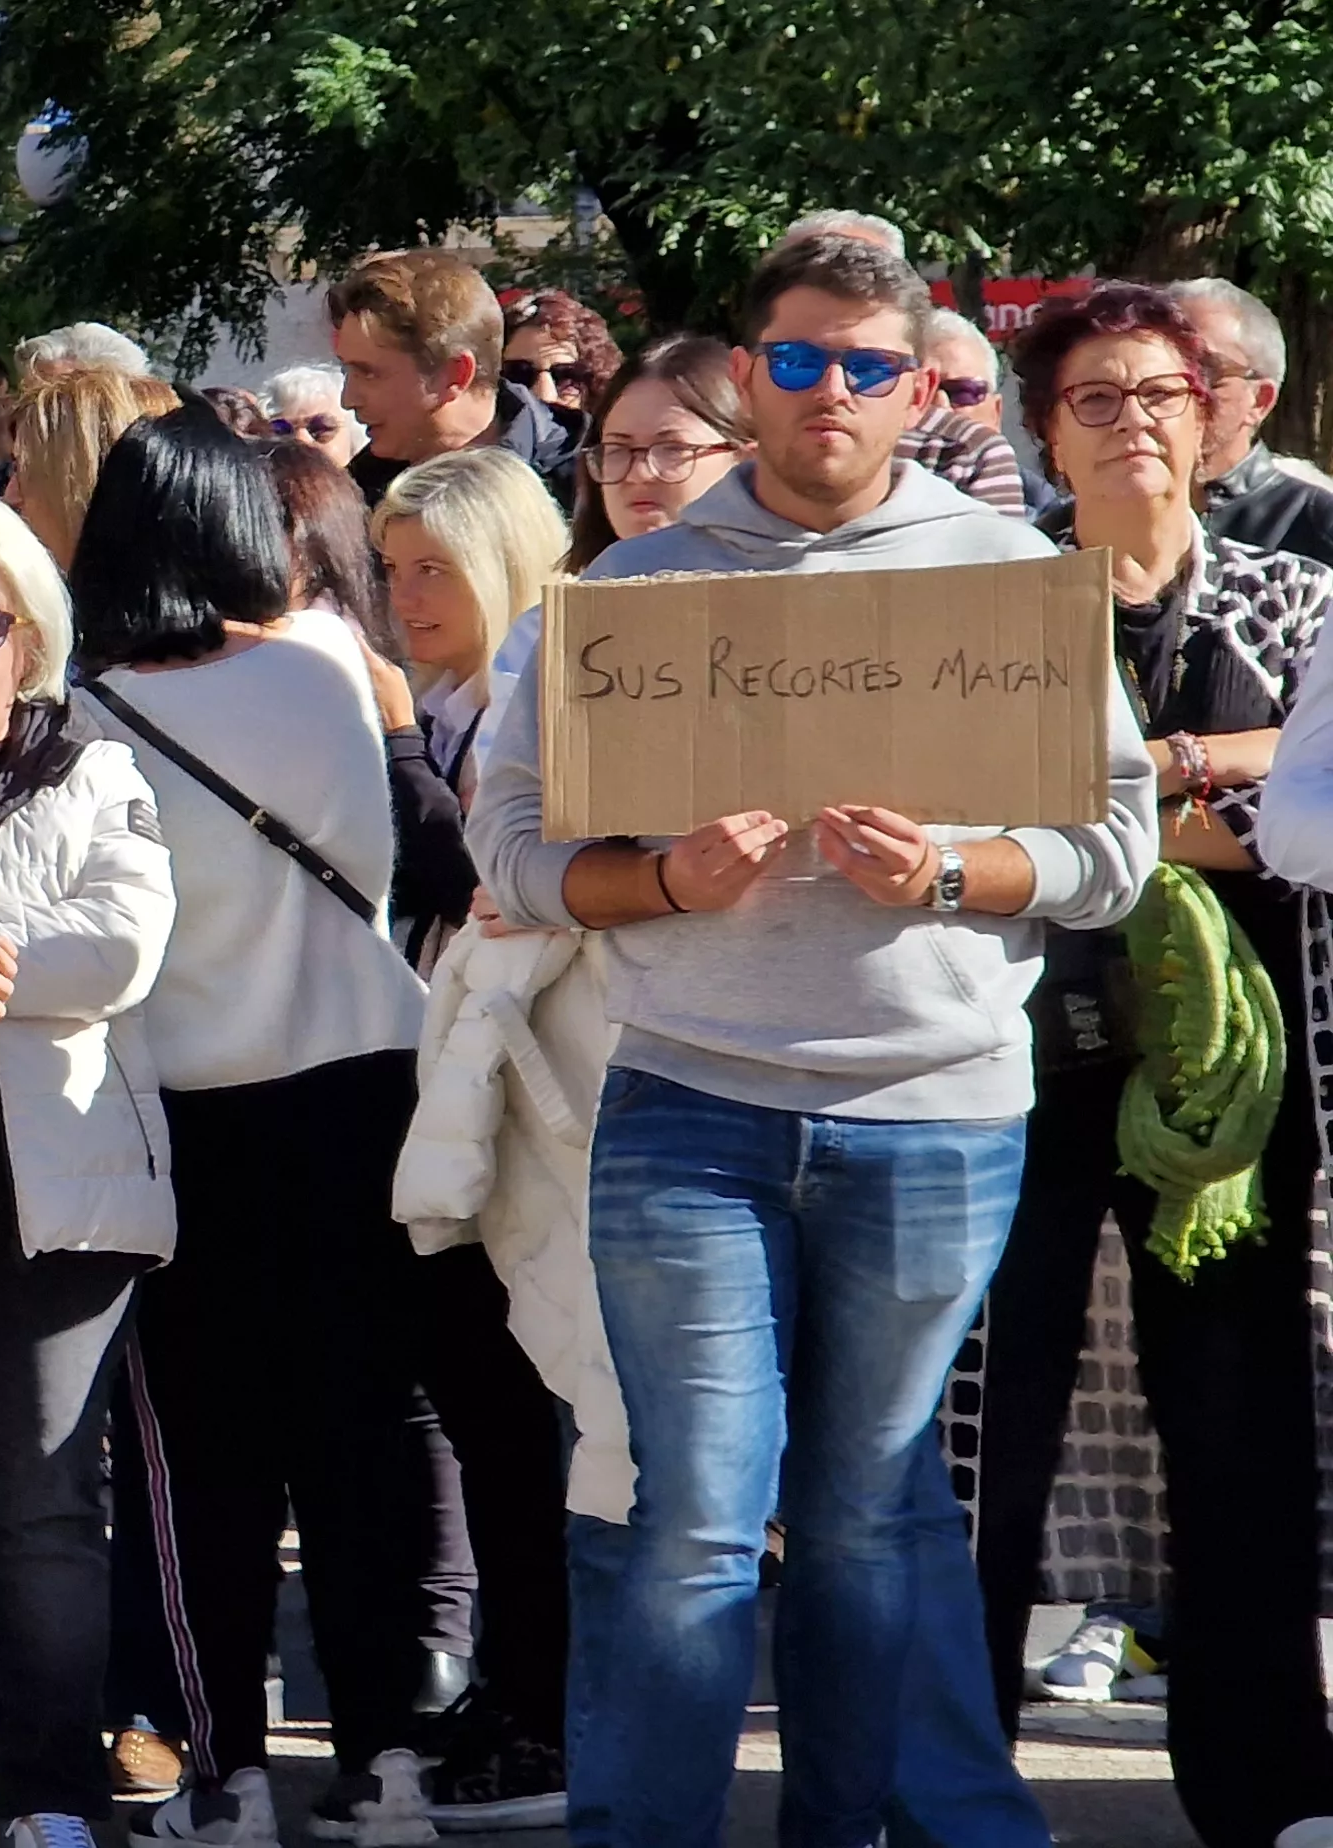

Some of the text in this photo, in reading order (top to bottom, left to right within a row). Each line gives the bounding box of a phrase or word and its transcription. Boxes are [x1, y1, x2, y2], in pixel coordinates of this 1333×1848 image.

[579, 634, 1069, 700] SUS RECORTES MATAN
